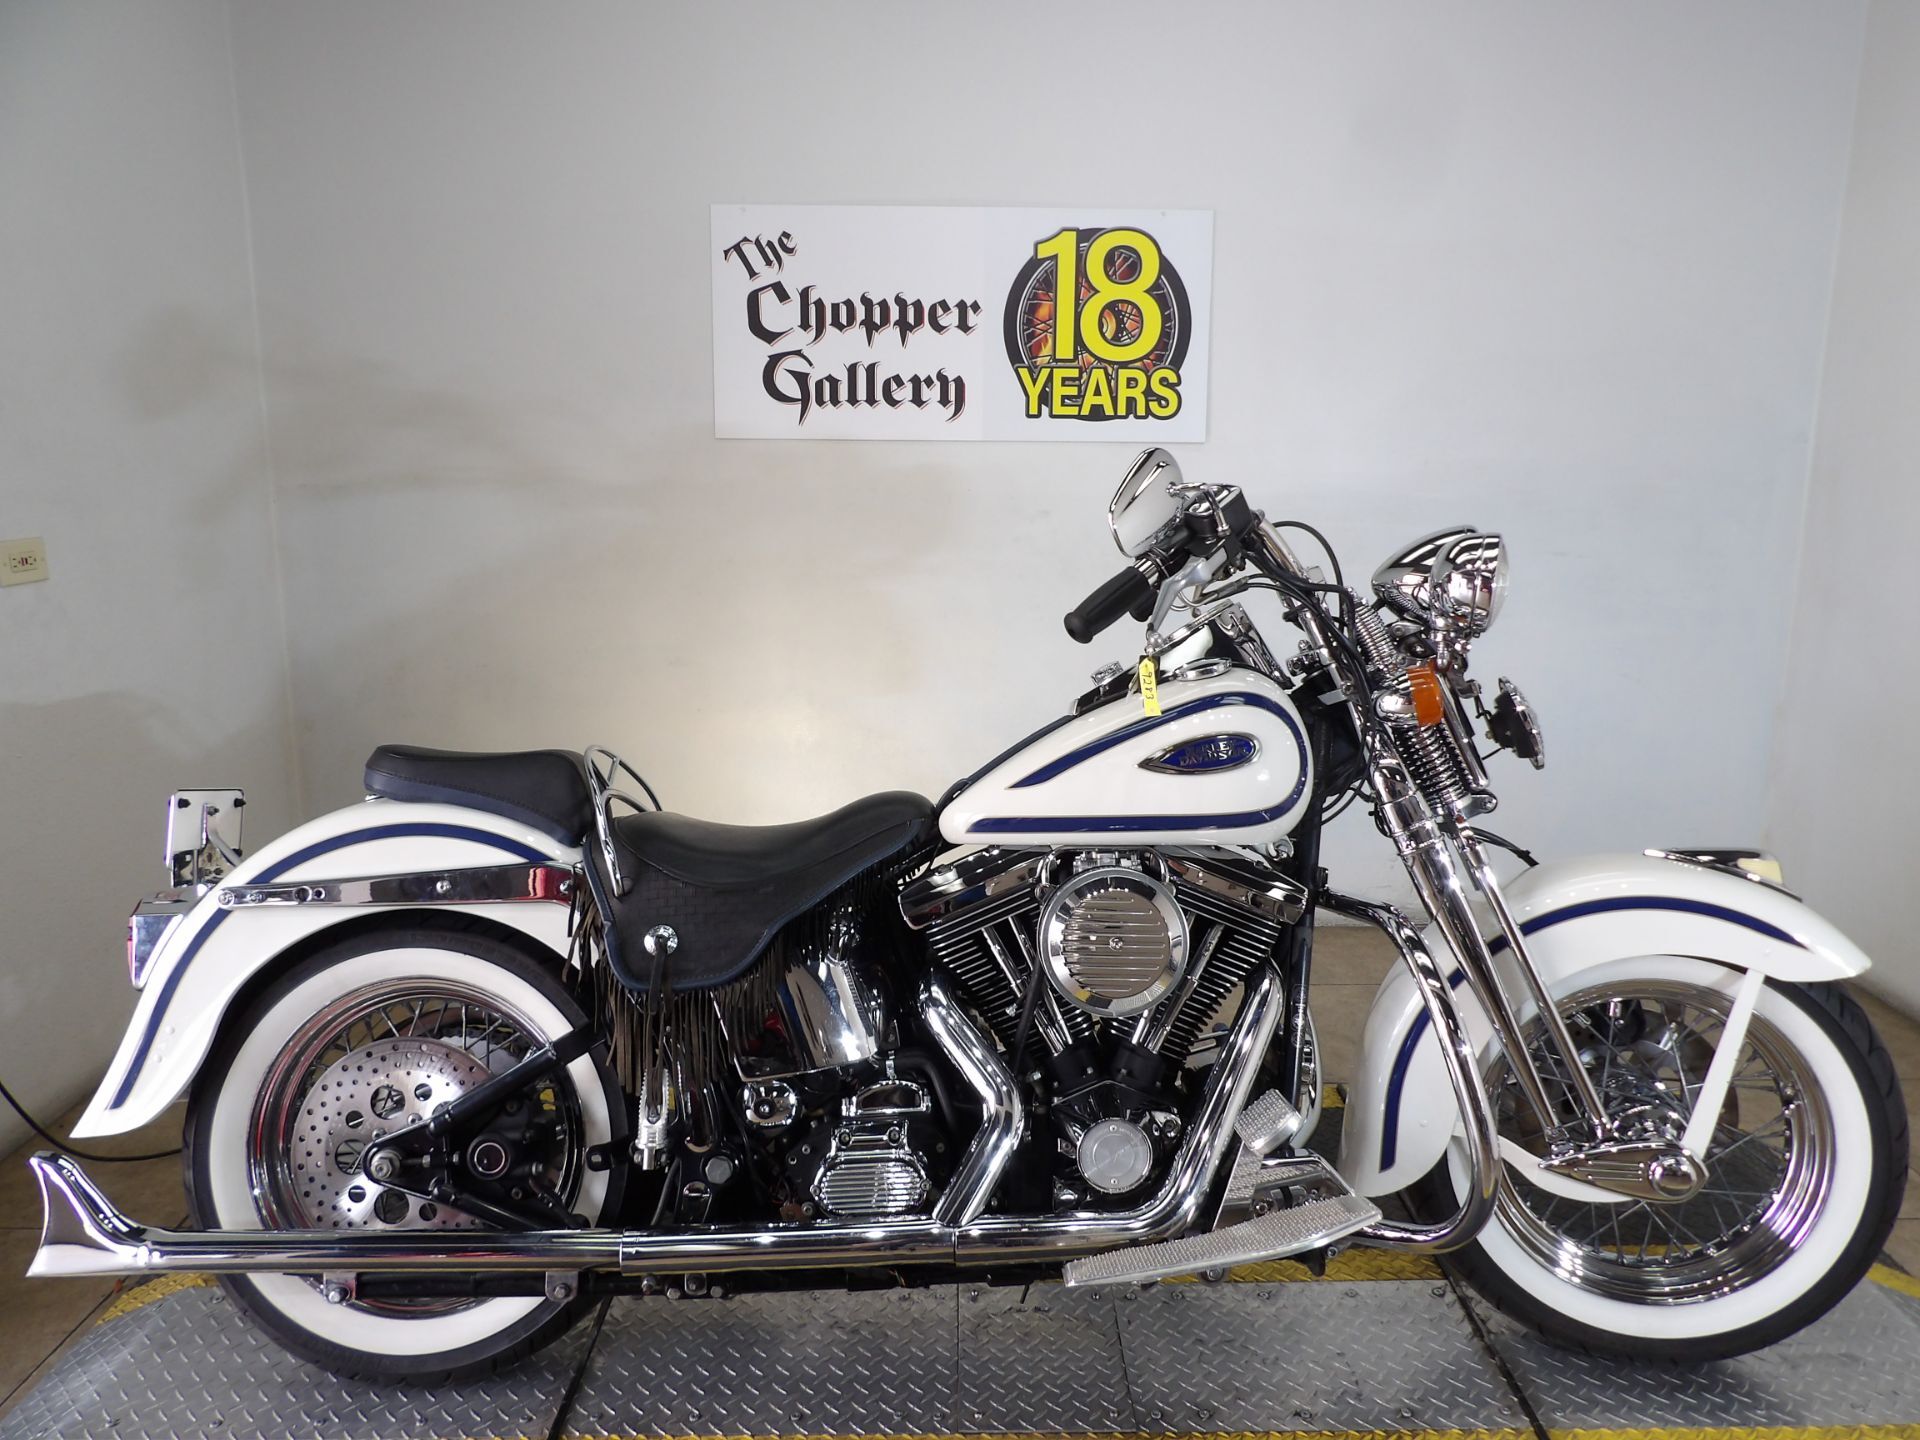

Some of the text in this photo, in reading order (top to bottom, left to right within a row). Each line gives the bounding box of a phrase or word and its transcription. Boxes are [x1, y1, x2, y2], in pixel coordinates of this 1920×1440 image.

[724, 229, 798, 281] The
[746, 280, 982, 349] Chopper
[1035, 227, 1164, 363] 18
[762, 348, 967, 427] Gallery
[1015, 363, 1183, 420] YEARS
